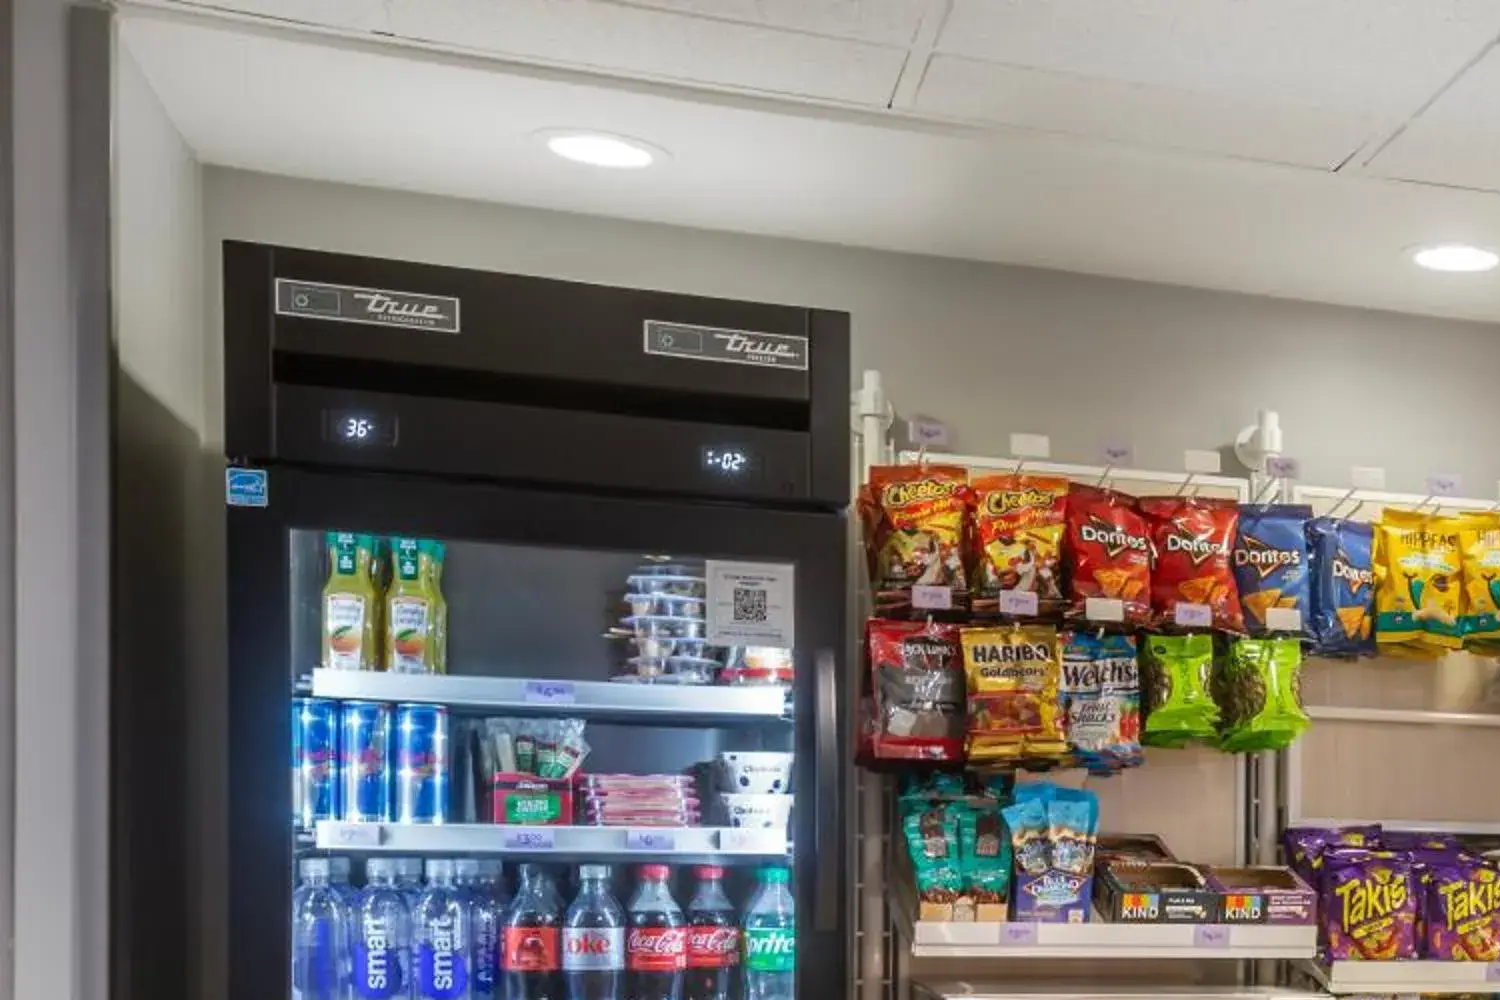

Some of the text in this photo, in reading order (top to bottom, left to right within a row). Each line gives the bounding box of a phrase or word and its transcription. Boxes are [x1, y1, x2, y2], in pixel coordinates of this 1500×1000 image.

[885, 482, 956, 504] Cheetos
[986, 489, 1056, 512] Cheetos
[1080, 524, 1147, 550] Doritos
[1235, 549, 1300, 566] Doritos
[972, 644, 1050, 663] HARIBO
[1063, 662, 1138, 687] Welch's
[1122, 906, 1159, 919] KIND
[1225, 906, 1261, 919] KIND
[1335, 873, 1407, 934] Takis
[365, 917, 387, 990] smart
[748, 931, 795, 954] prite
[430, 918, 453, 991] smart
